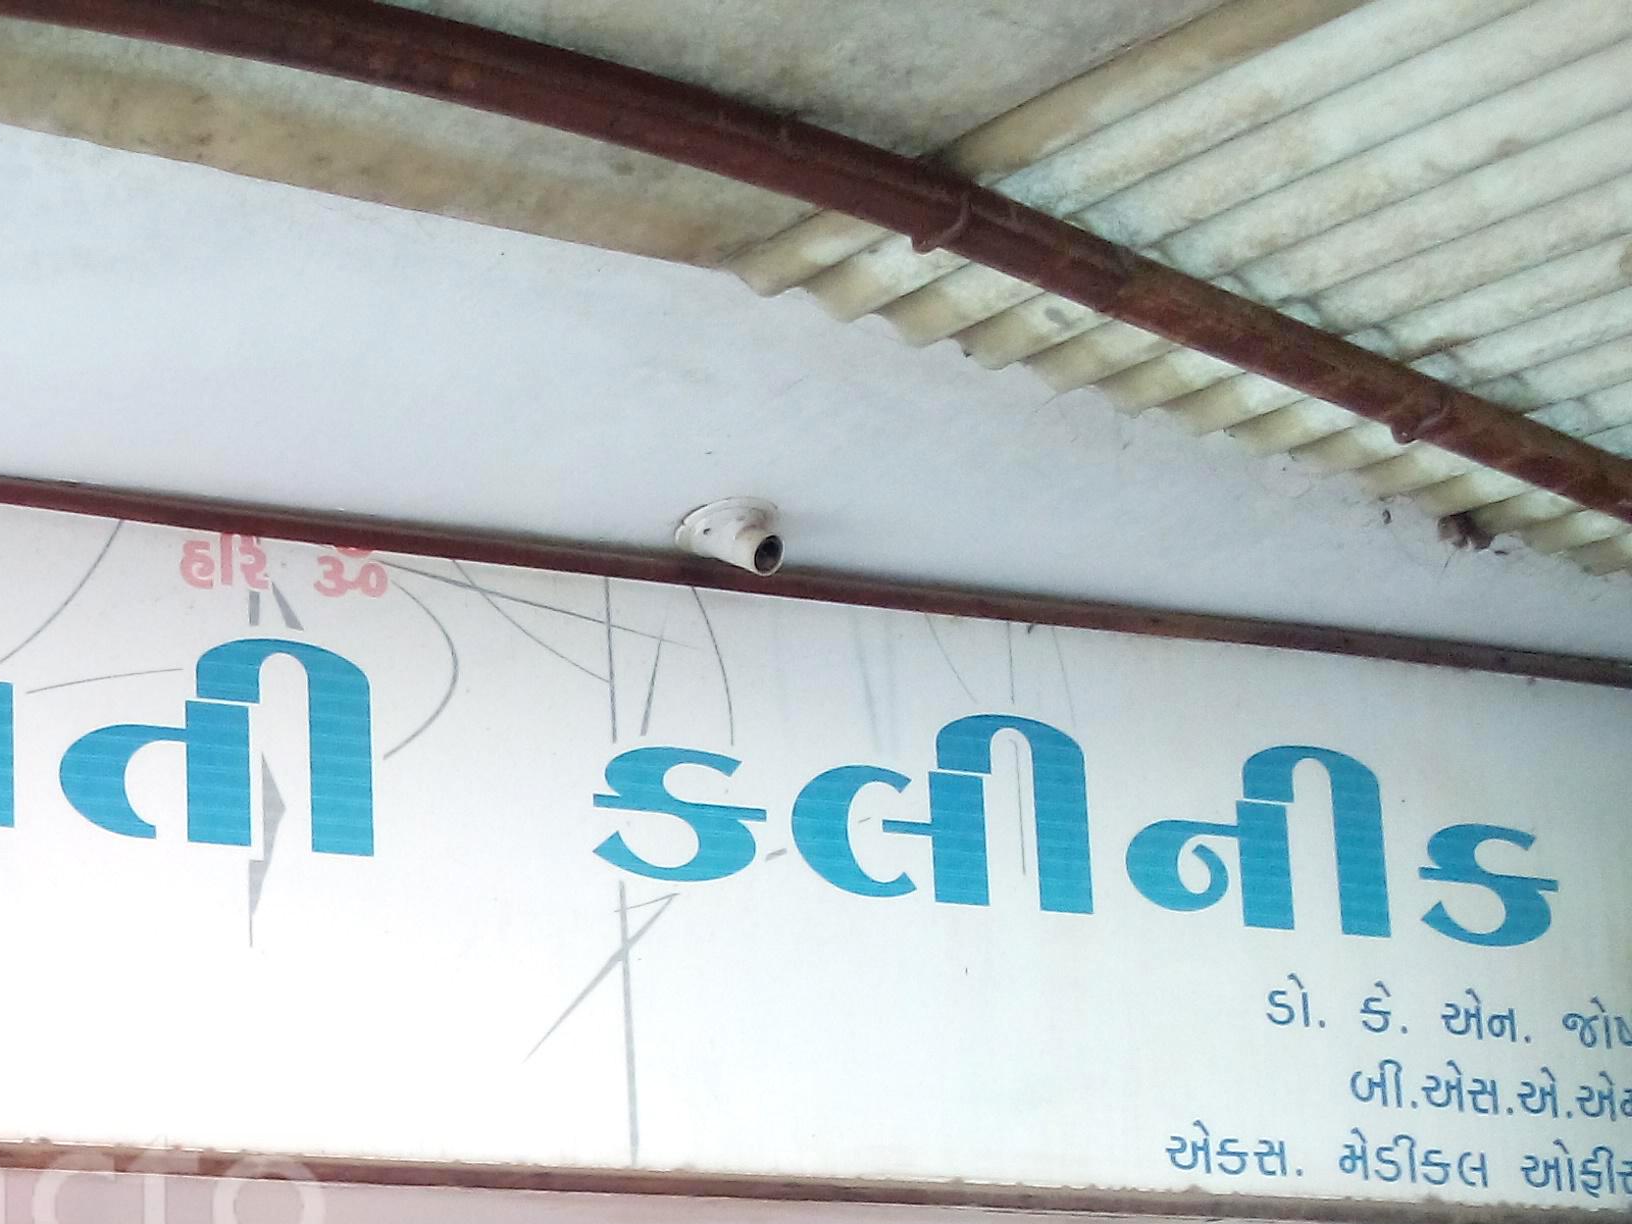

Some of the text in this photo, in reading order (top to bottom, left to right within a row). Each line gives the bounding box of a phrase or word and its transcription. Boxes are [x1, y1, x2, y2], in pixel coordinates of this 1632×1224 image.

[592, 712, 1560, 948] કલીનીક
[1266, 973, 1326, 1029] ડો.
[1360, 981, 1409, 1034] કે.
[1441, 988, 1531, 1044] એન.
[1339, 1128, 1488, 1188] મેડીકલ
